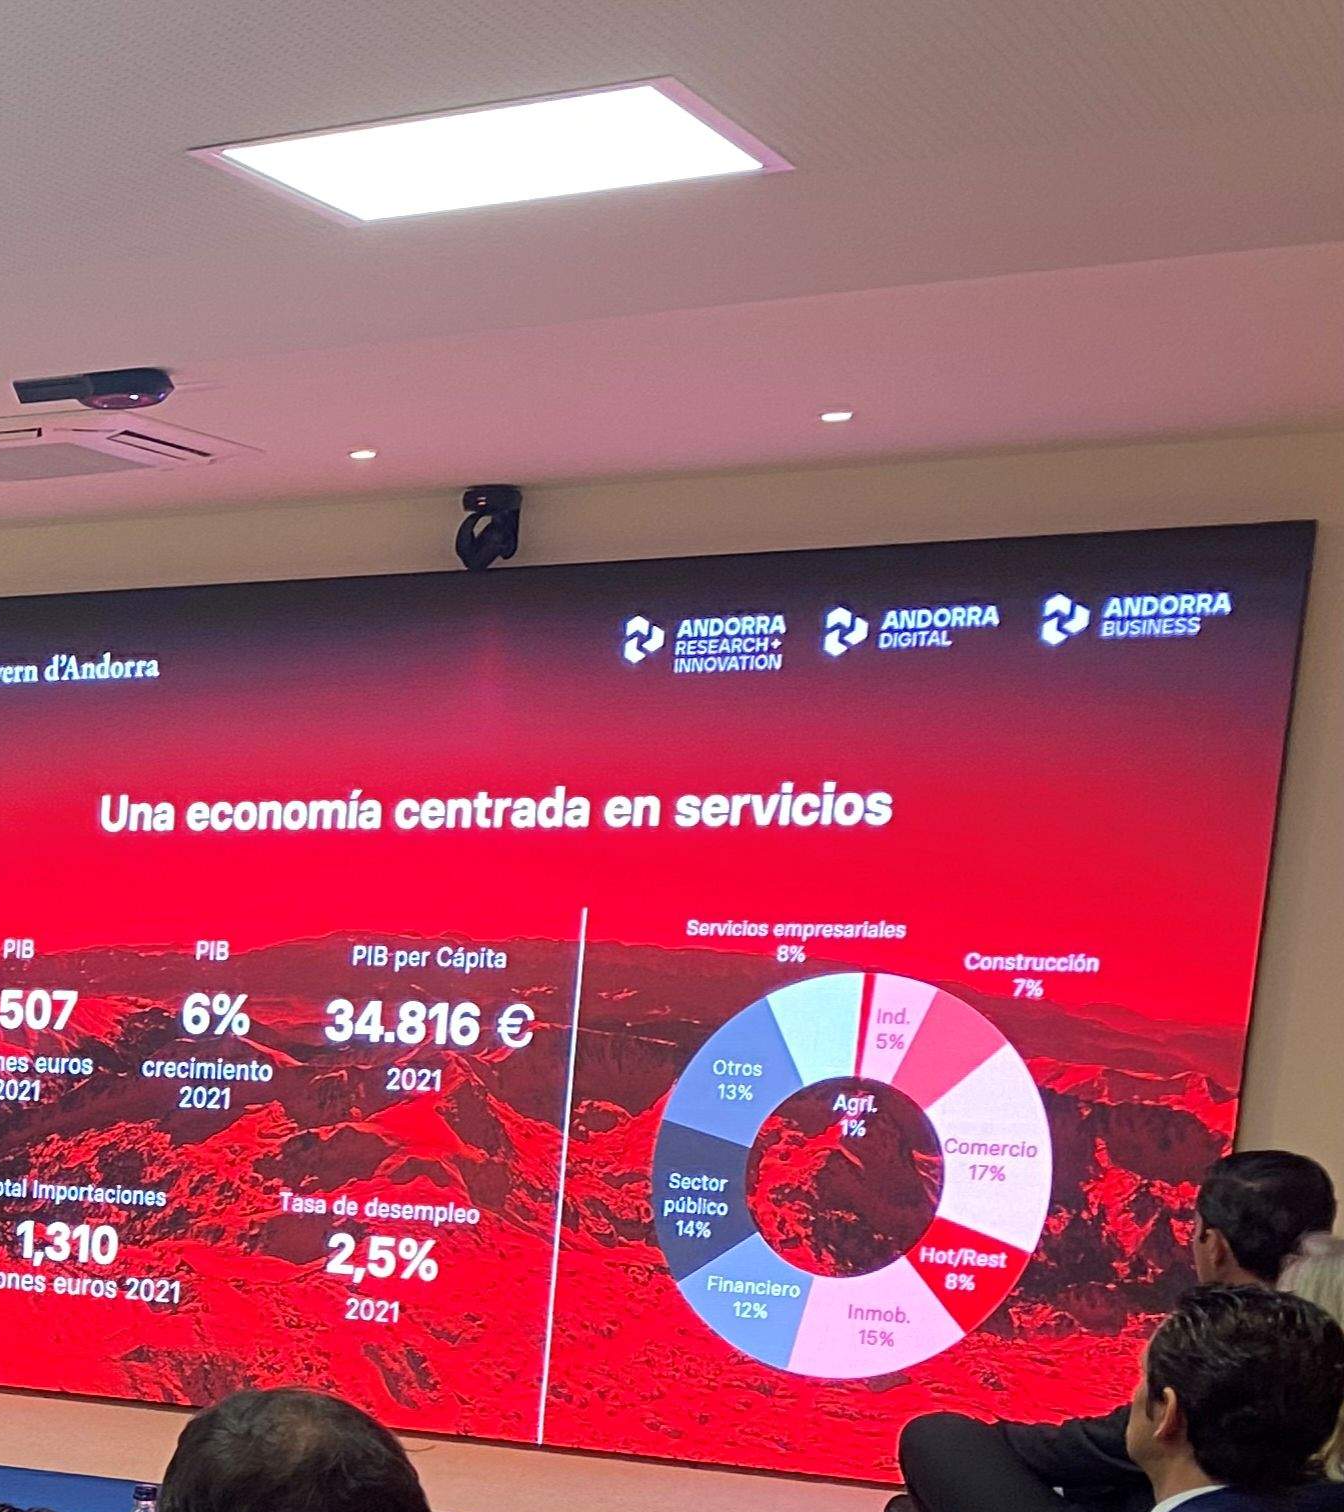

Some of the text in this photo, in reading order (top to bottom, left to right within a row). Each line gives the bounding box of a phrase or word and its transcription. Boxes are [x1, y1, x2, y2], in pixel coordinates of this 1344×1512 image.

[1103, 592, 1232, 617] ANDORRA
[676, 615, 787, 637] ANDORRA
[880, 605, 1000, 630] ANDORRA
[1101, 616, 1201, 637] BUSINESS
[674, 636, 782, 655] RESEARCH+
[878, 630, 952, 649] DIGITAL
[44, 653, 159, 683] d'Andorra
[673, 653, 782, 673] INNOVATION
[99, 781, 893, 832] Una economía centrada en servicios
[686, 919, 906, 941] Servicios empresariales
[2, 938, 35, 961] PIB
[195, 940, 230, 962] PIB
[352, 944, 508, 971] PIB per Cápita
[776, 945, 806, 963] 8%
[964, 952, 1100, 973] Construcción
[1013, 979, 1043, 998] 7%
[181, 991, 250, 1037] 6%
[324, 998, 536, 1048] 34.816 €
[876, 1008, 910, 1026] Ind.
[875, 1032, 905, 1051] 5%
[35, 1056, 94, 1076] euros
[141, 1057, 274, 1083] crecimiento
[712, 1059, 763, 1078] Otros
[386, 1067, 442, 1092] 2021
[178, 1087, 231, 1110] 2021
[717, 1084, 753, 1101] 13%
[832, 1094, 878, 1114] Agri.
[839, 1120, 867, 1137] 1%
[944, 1138, 1038, 1159] Comercio
[668, 1173, 728, 1193] Sector
[969, 1165, 1006, 1183] 17%
[32, 1179, 167, 1207] Importaciones
[280, 1192, 481, 1226] Tasa de desempleo
[663, 1196, 729, 1217] público
[675, 1221, 711, 1239] 14%
[16, 1220, 119, 1268] 1,310
[325, 1233, 439, 1284] 2,5%
[919, 1247, 1007, 1269] Hot/Rest
[52, 1276, 117, 1300] euros
[124, 1277, 181, 1303] 2021
[707, 1276, 801, 1299] Financiero
[945, 1273, 975, 1292] 8%
[344, 1298, 401, 1323] 2021
[732, 1302, 768, 1319] 12%
[847, 1303, 910, 1324] Inmob.
[858, 1330, 895, 1347] 15%
